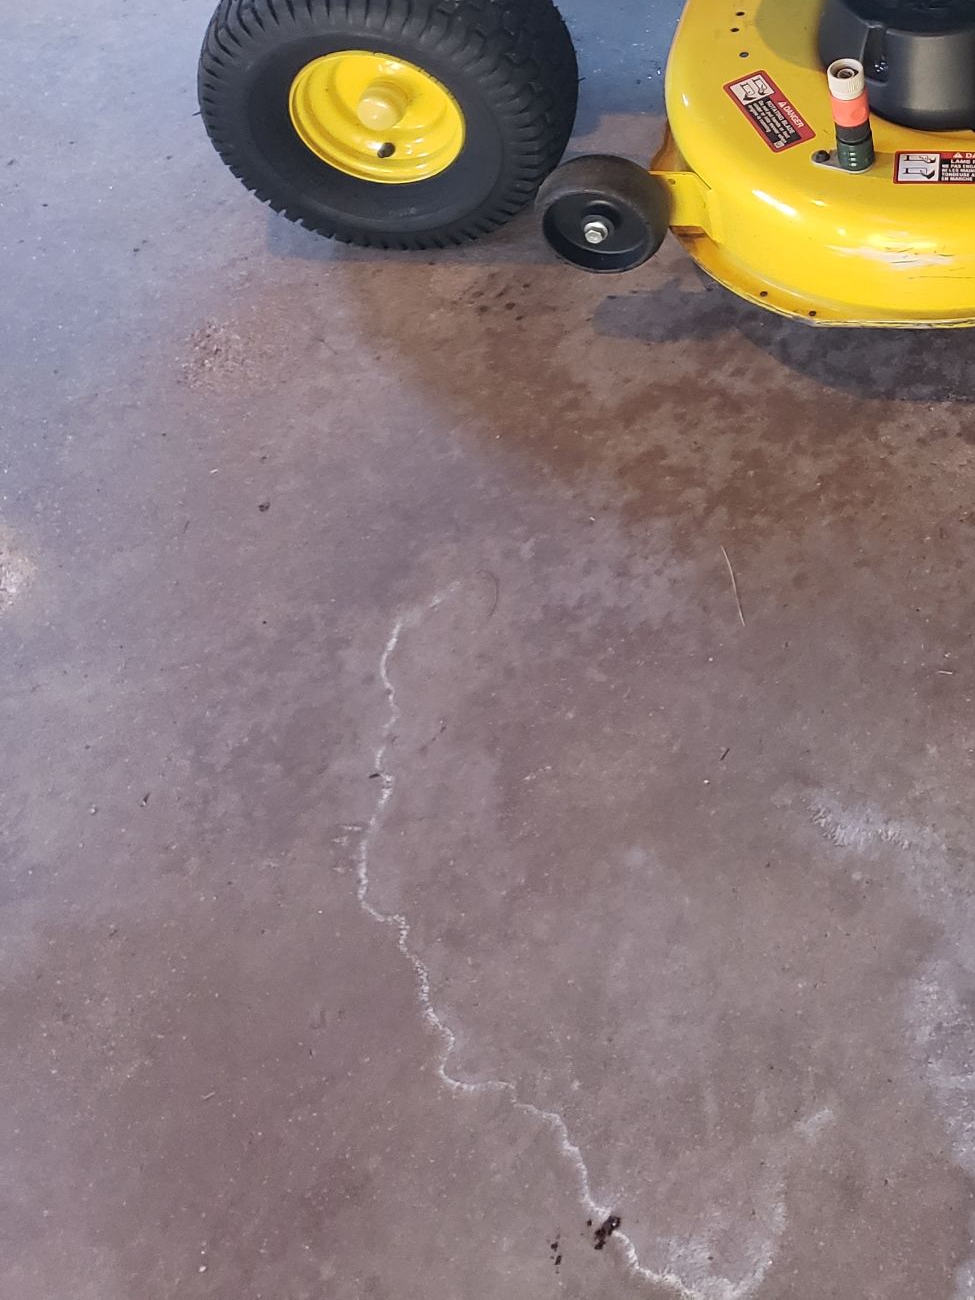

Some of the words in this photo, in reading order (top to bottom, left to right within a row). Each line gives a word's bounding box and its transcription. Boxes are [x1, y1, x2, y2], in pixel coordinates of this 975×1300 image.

[766, 100, 785, 120] ROTATING
[781, 120, 795, 134] BLADE
[783, 106, 804, 128] DANGER
